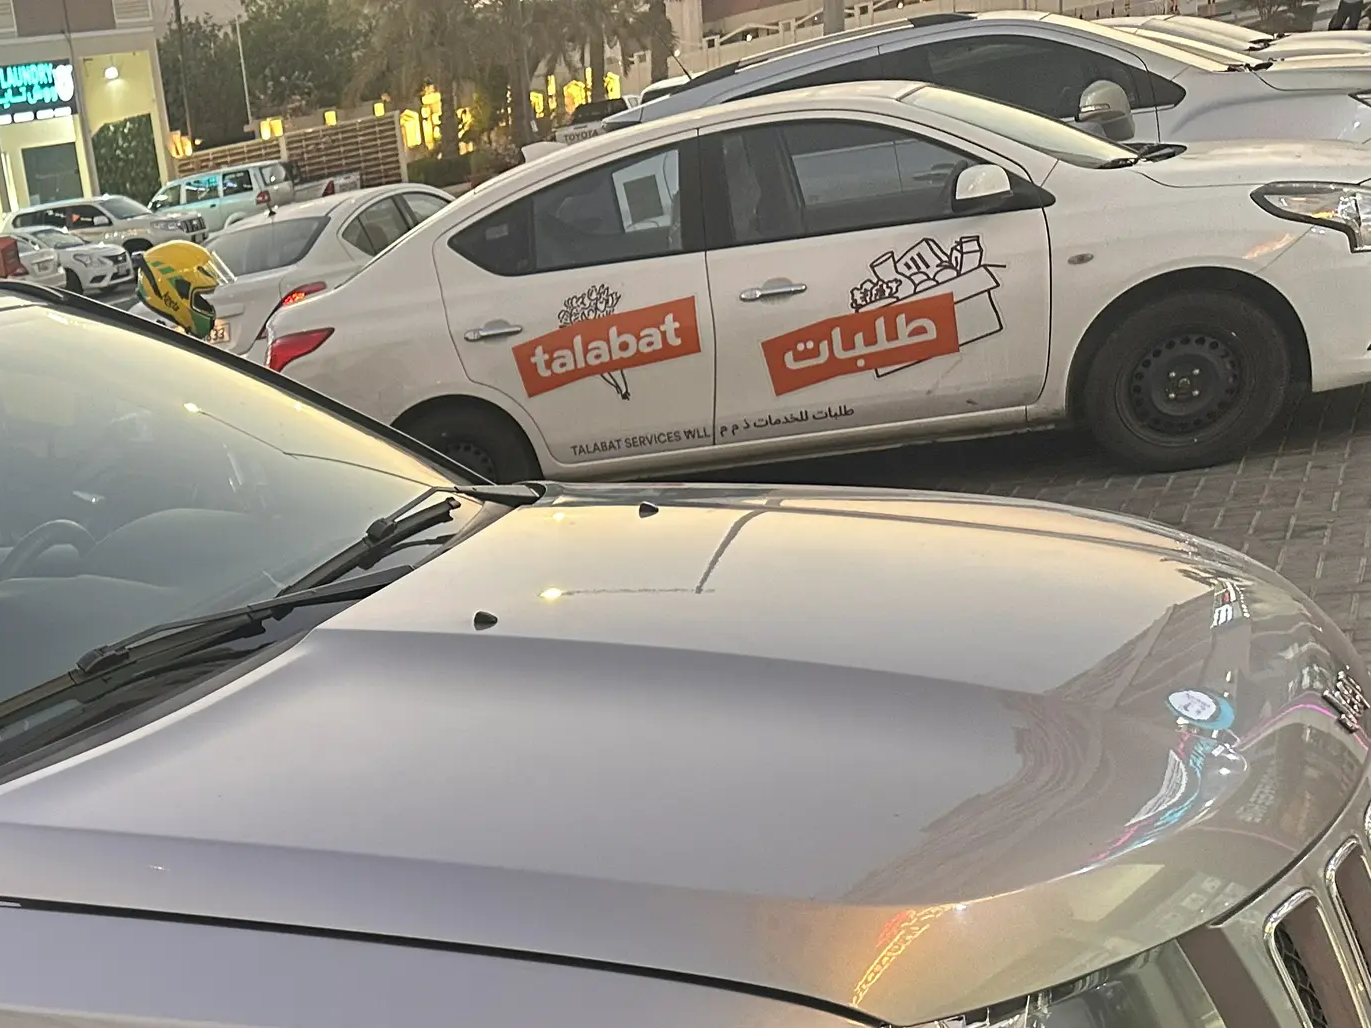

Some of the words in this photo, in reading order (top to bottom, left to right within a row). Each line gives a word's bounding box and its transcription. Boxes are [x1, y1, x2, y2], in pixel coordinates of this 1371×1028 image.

[0, 63, 53, 89] LAUNDRY
[564, 129, 599, 144] TOYOTA
[530, 312, 683, 378] talabat
[783, 311, 938, 372] طلبات
[753, 410, 809, 429] للخدمات
[812, 405, 855, 420] طلبات
[570, 438, 623, 456] TALABAT
[625, 430, 682, 449] SERVICES
[683, 427, 711, 441] WLL
